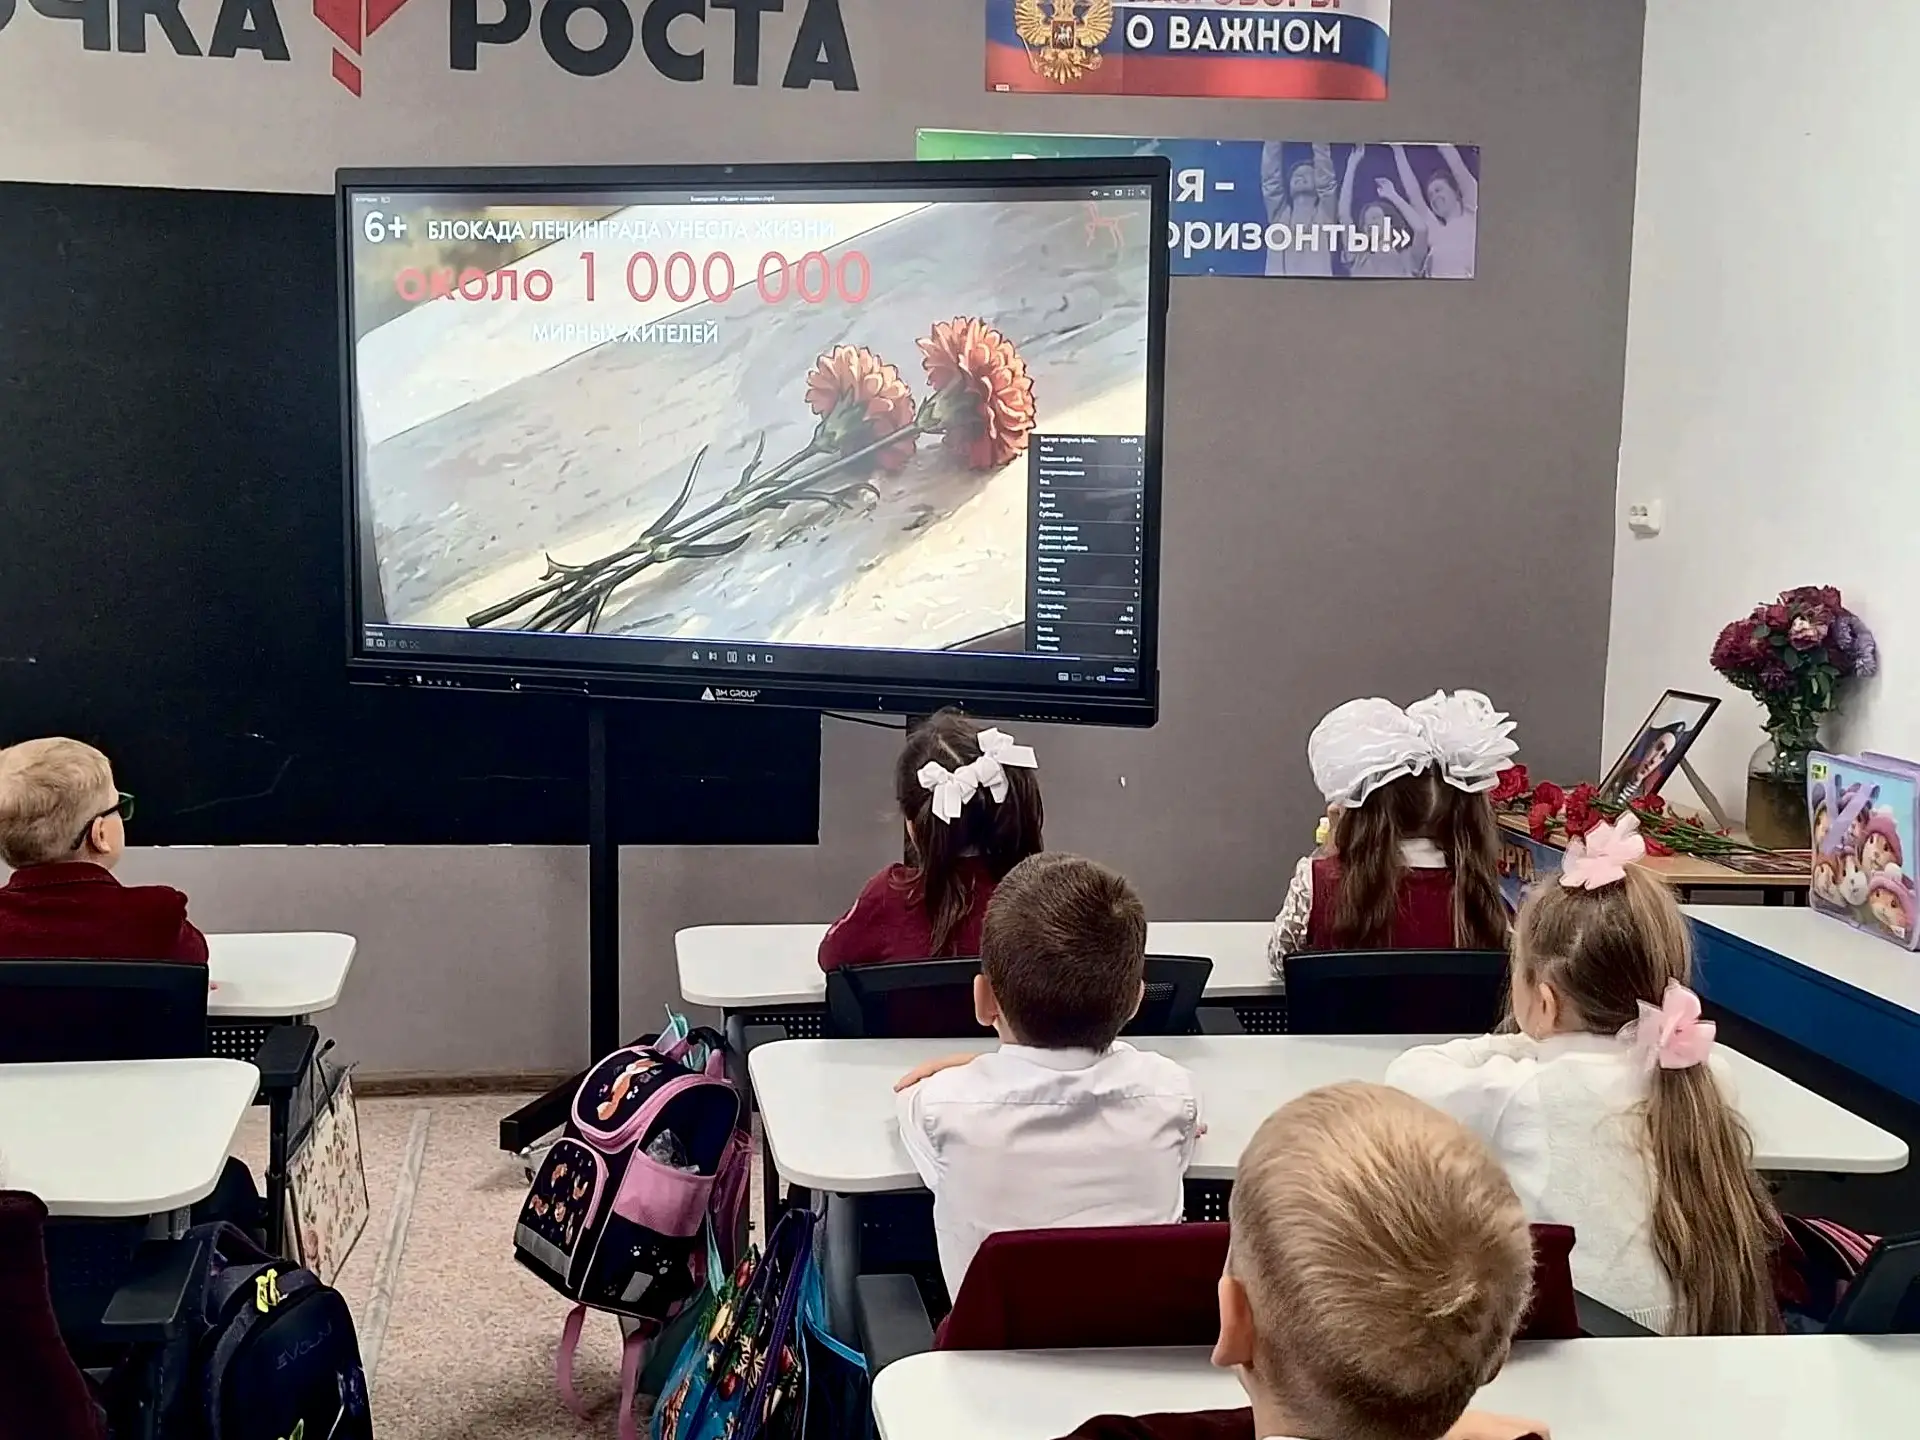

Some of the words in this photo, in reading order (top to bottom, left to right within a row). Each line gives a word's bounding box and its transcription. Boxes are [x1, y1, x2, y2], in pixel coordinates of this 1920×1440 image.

[0, 0, 291, 61] ЧКА
[450, 0, 859, 92] РОСТА
[1126, 14, 1154, 49] О
[1168, 16, 1341, 54] ВАЖНОМ
[1170, 168, 1205, 203] я
[363, 210, 408, 243] 6+
[427, 220, 526, 243] БЛОКАДА
[529, 219, 661, 243] ЛЕНИНГРАДА
[666, 220, 748, 240] УНЕСЛА
[755, 219, 836, 240] ЖИЗНИ
[395, 266, 554, 302] около
[579, 251, 596, 302] 1
[626, 250, 735, 303] 000
[757, 250, 872, 304] 000
[531, 322, 620, 344] МИРНЫХ
[621, 319, 719, 344] ЖИТЕЛЕЙ
[729, 689, 758, 698] GROUP
